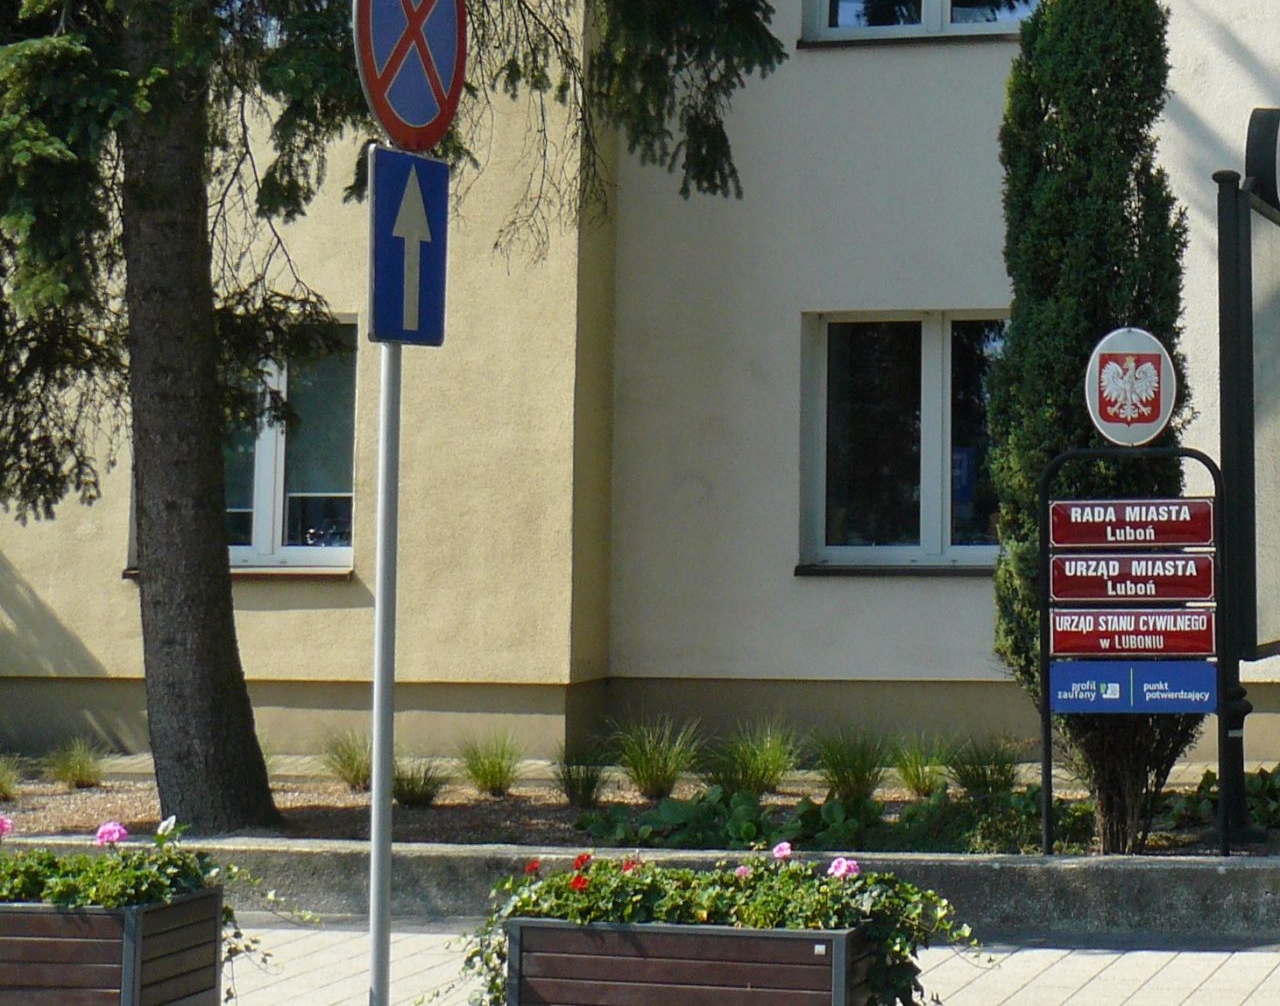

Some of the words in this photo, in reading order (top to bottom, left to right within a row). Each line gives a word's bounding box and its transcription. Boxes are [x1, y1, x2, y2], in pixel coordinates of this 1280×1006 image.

[1070, 506, 1117, 523] RADA
[1125, 505, 1191, 522] MIASTA
[1106, 525, 1155, 541] Luboń
[1065, 560, 1120, 580] URZĄD
[1131, 560, 1197, 577] MIASTA
[1107, 580, 1156, 596] Luboń
[1055, 615, 1094, 634] URZĄD
[1099, 615, 1135, 632] STANU
[1139, 615, 1207, 631] CYWILNEGO
[1100, 638, 1110, 649] w
[1115, 635, 1164, 649] LUBONIU
[1071, 681, 1096, 692] profil
[1143, 681, 1169, 691] punkt
[1057, 690, 1097, 702] zaufany
[1145, 690, 1210, 702] potwierdzający
